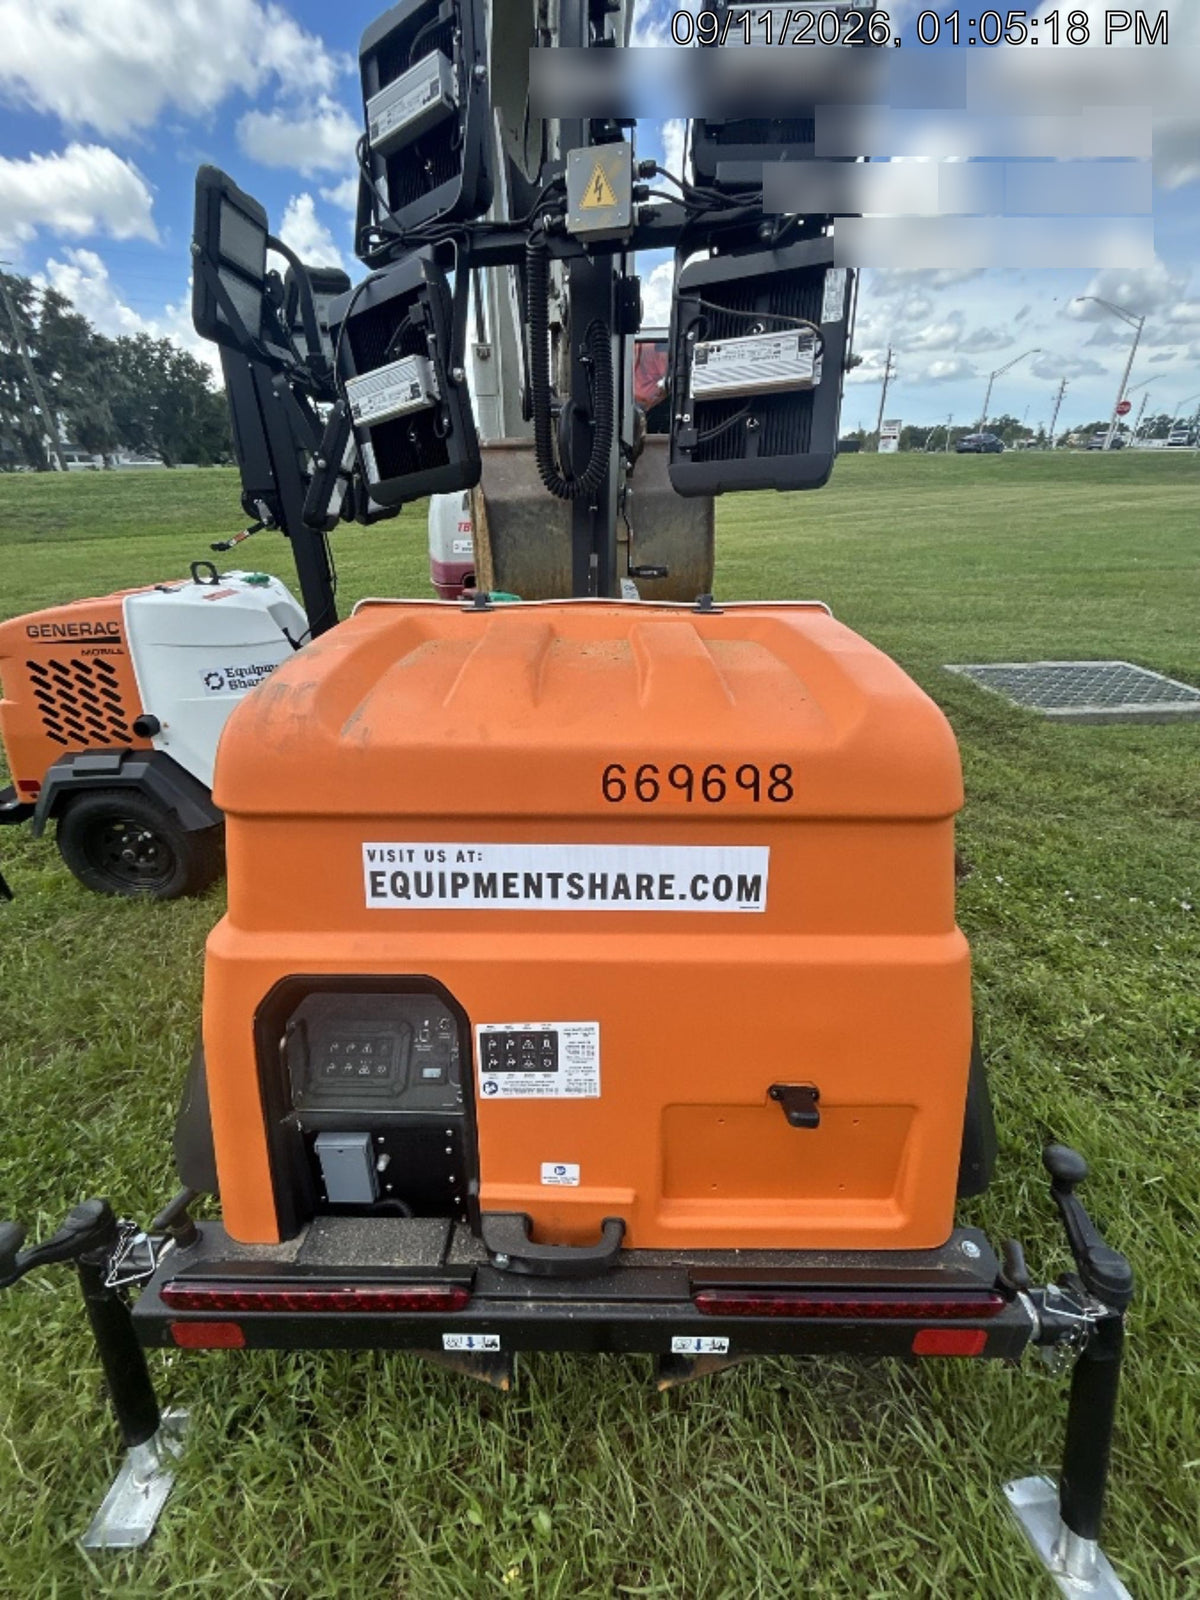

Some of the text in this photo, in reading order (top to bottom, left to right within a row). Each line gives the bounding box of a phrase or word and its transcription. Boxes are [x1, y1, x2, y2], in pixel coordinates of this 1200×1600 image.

[457, 521, 473, 533] TB
[26, 621, 120, 638] GENERAC
[223, 664, 279, 678] Equipm
[601, 764, 794, 802] 669698
[367, 849, 483, 864] VISIT US AT:
[369, 870, 762, 903] EQUIPMENTSHARE.COM
